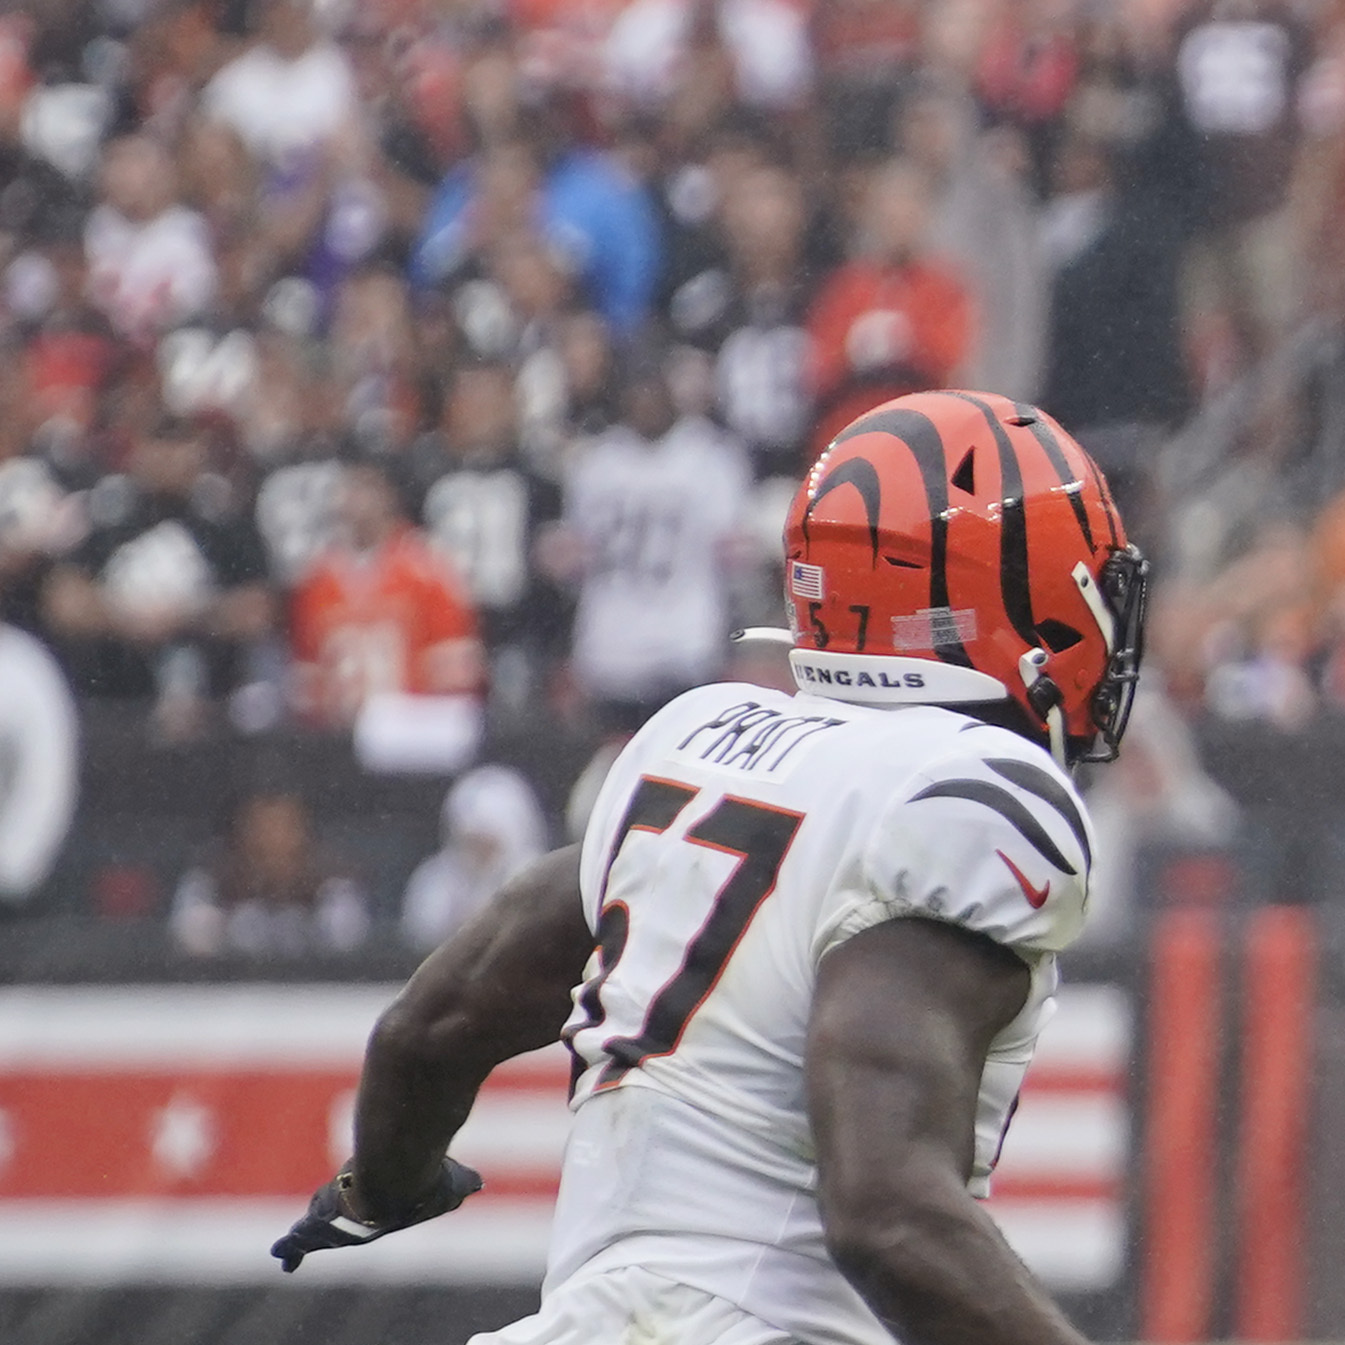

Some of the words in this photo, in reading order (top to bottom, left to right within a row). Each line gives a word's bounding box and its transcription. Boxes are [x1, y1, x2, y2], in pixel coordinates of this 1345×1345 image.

[795, 664, 925, 688] ENGALS
[676, 701, 848, 772] PRATT
[560, 773, 807, 1106] 57
